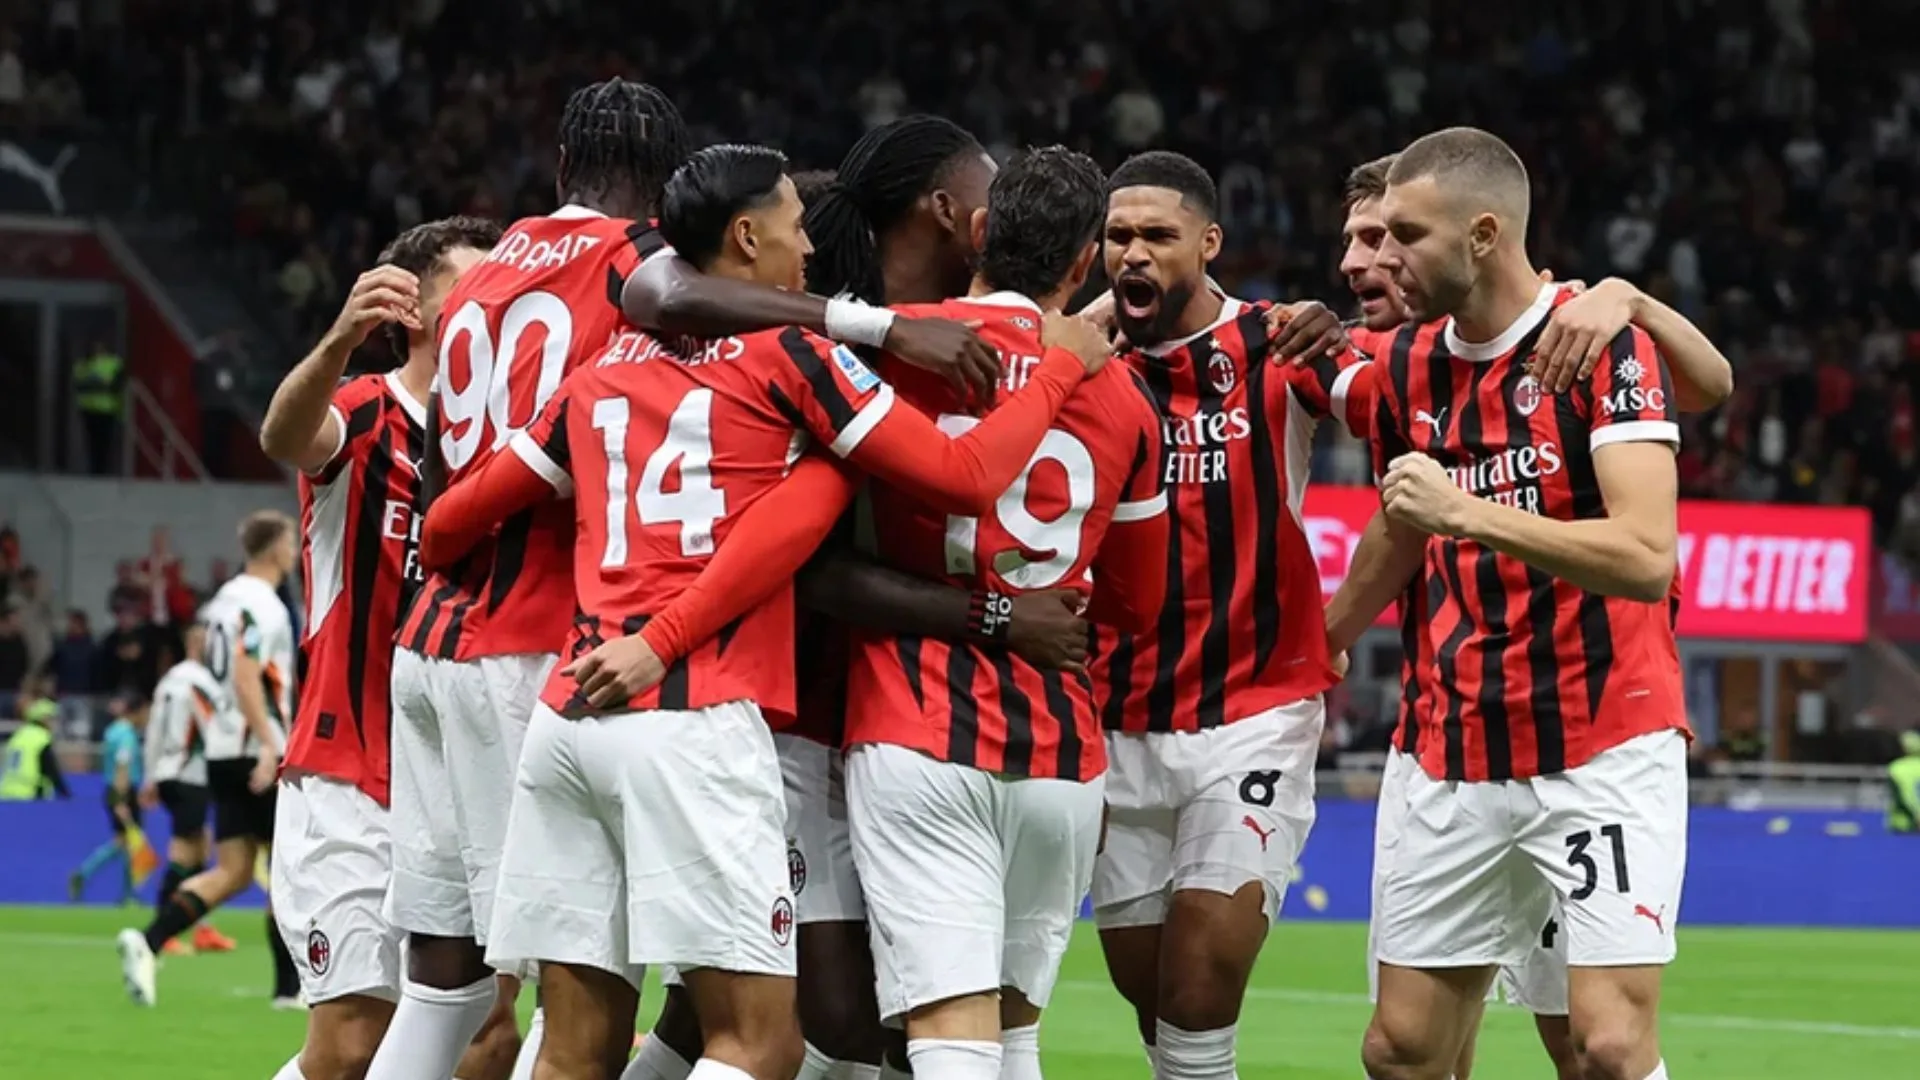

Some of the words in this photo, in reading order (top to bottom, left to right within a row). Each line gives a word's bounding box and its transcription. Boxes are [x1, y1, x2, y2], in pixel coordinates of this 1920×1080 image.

[440, 290, 573, 470] 90
[1600, 387, 1666, 416] MSC
[592, 387, 727, 568] 14
[1164, 451, 1227, 483] ETTER
[1697, 533, 1853, 614] BETTER
[1239, 769, 1283, 807] 8
[1564, 823, 1630, 900] 31
